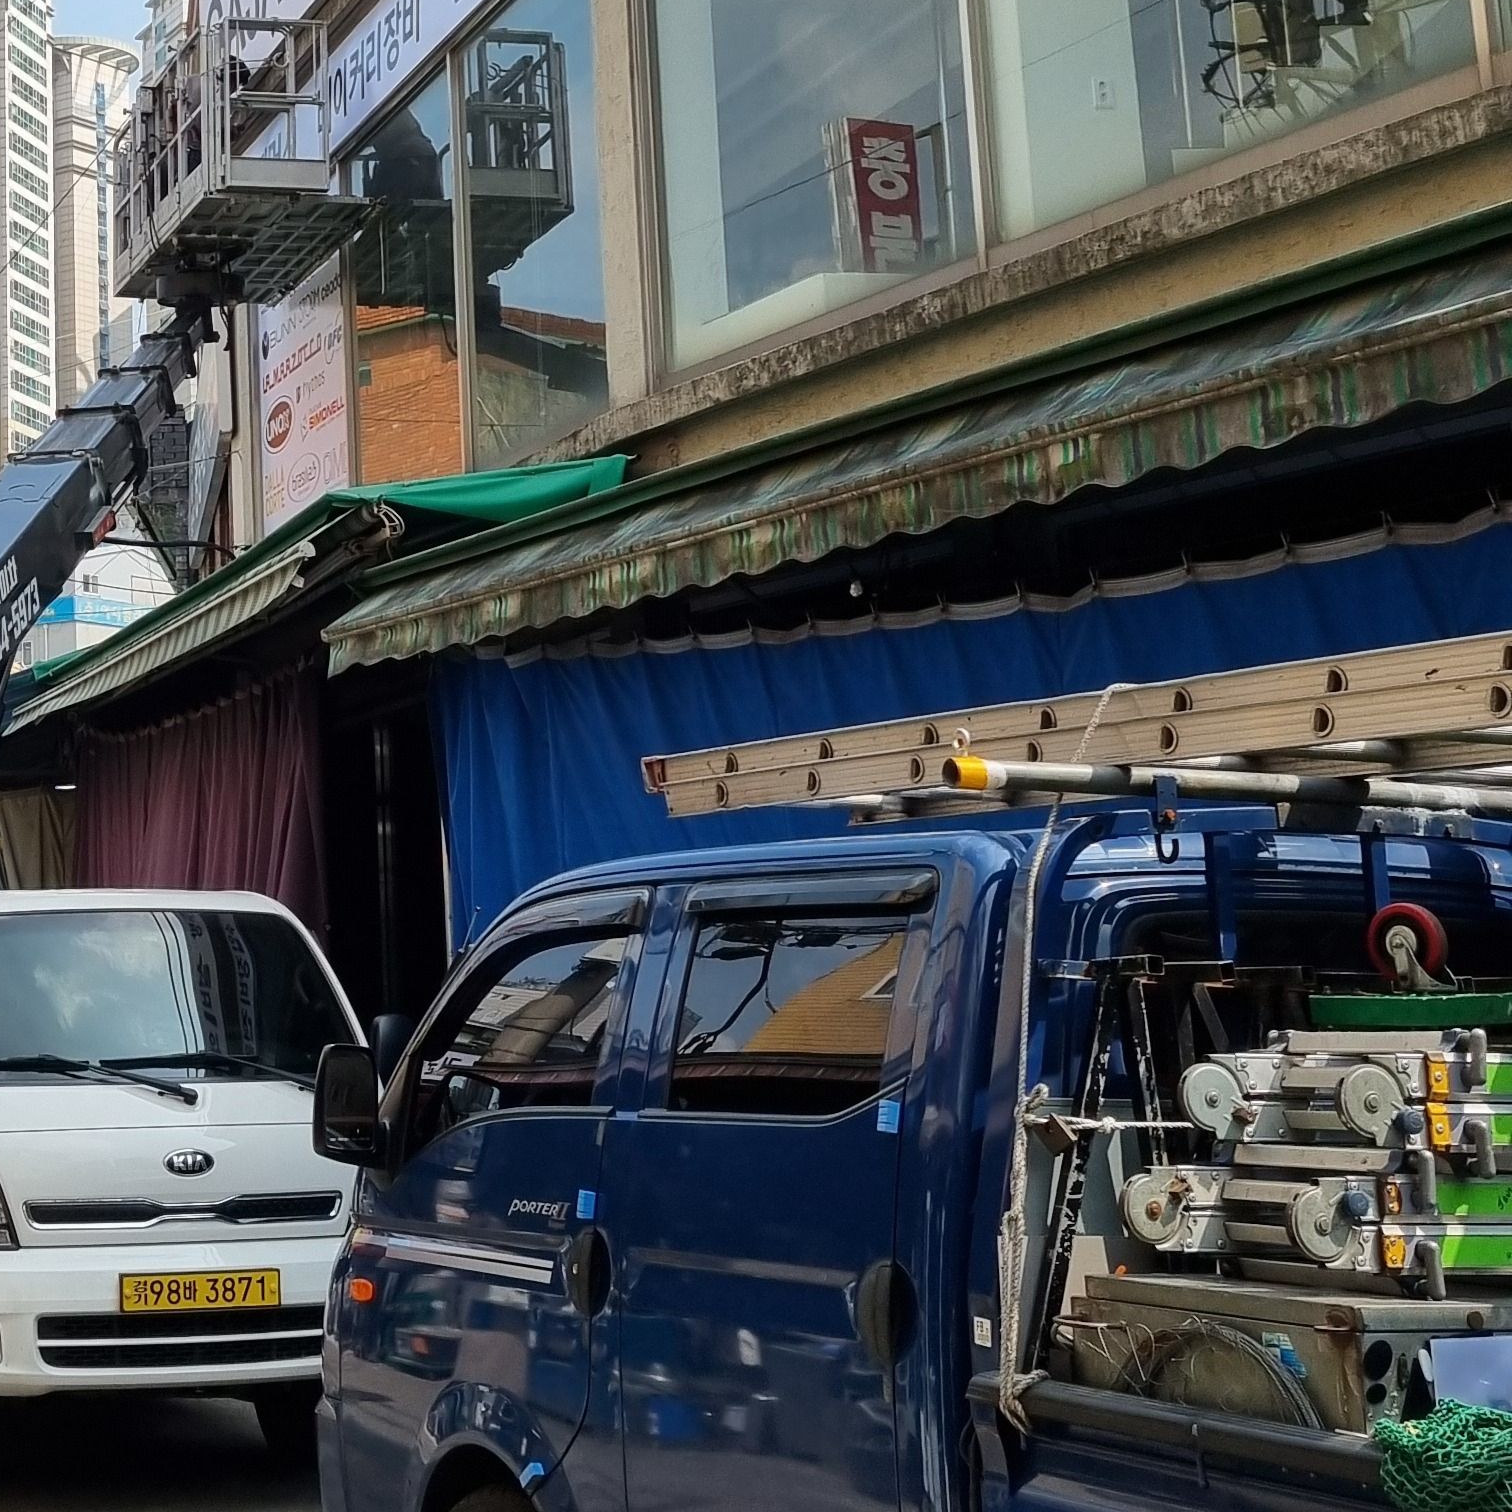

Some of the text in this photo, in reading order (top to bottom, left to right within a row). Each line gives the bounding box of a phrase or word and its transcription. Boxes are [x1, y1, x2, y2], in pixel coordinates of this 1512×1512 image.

[266, 407, 290, 442] UNOX
[172, 1154, 206, 1172] KIA
[508, 1199, 558, 1216] PORTER
[205, 1275, 265, 1304] 3871
